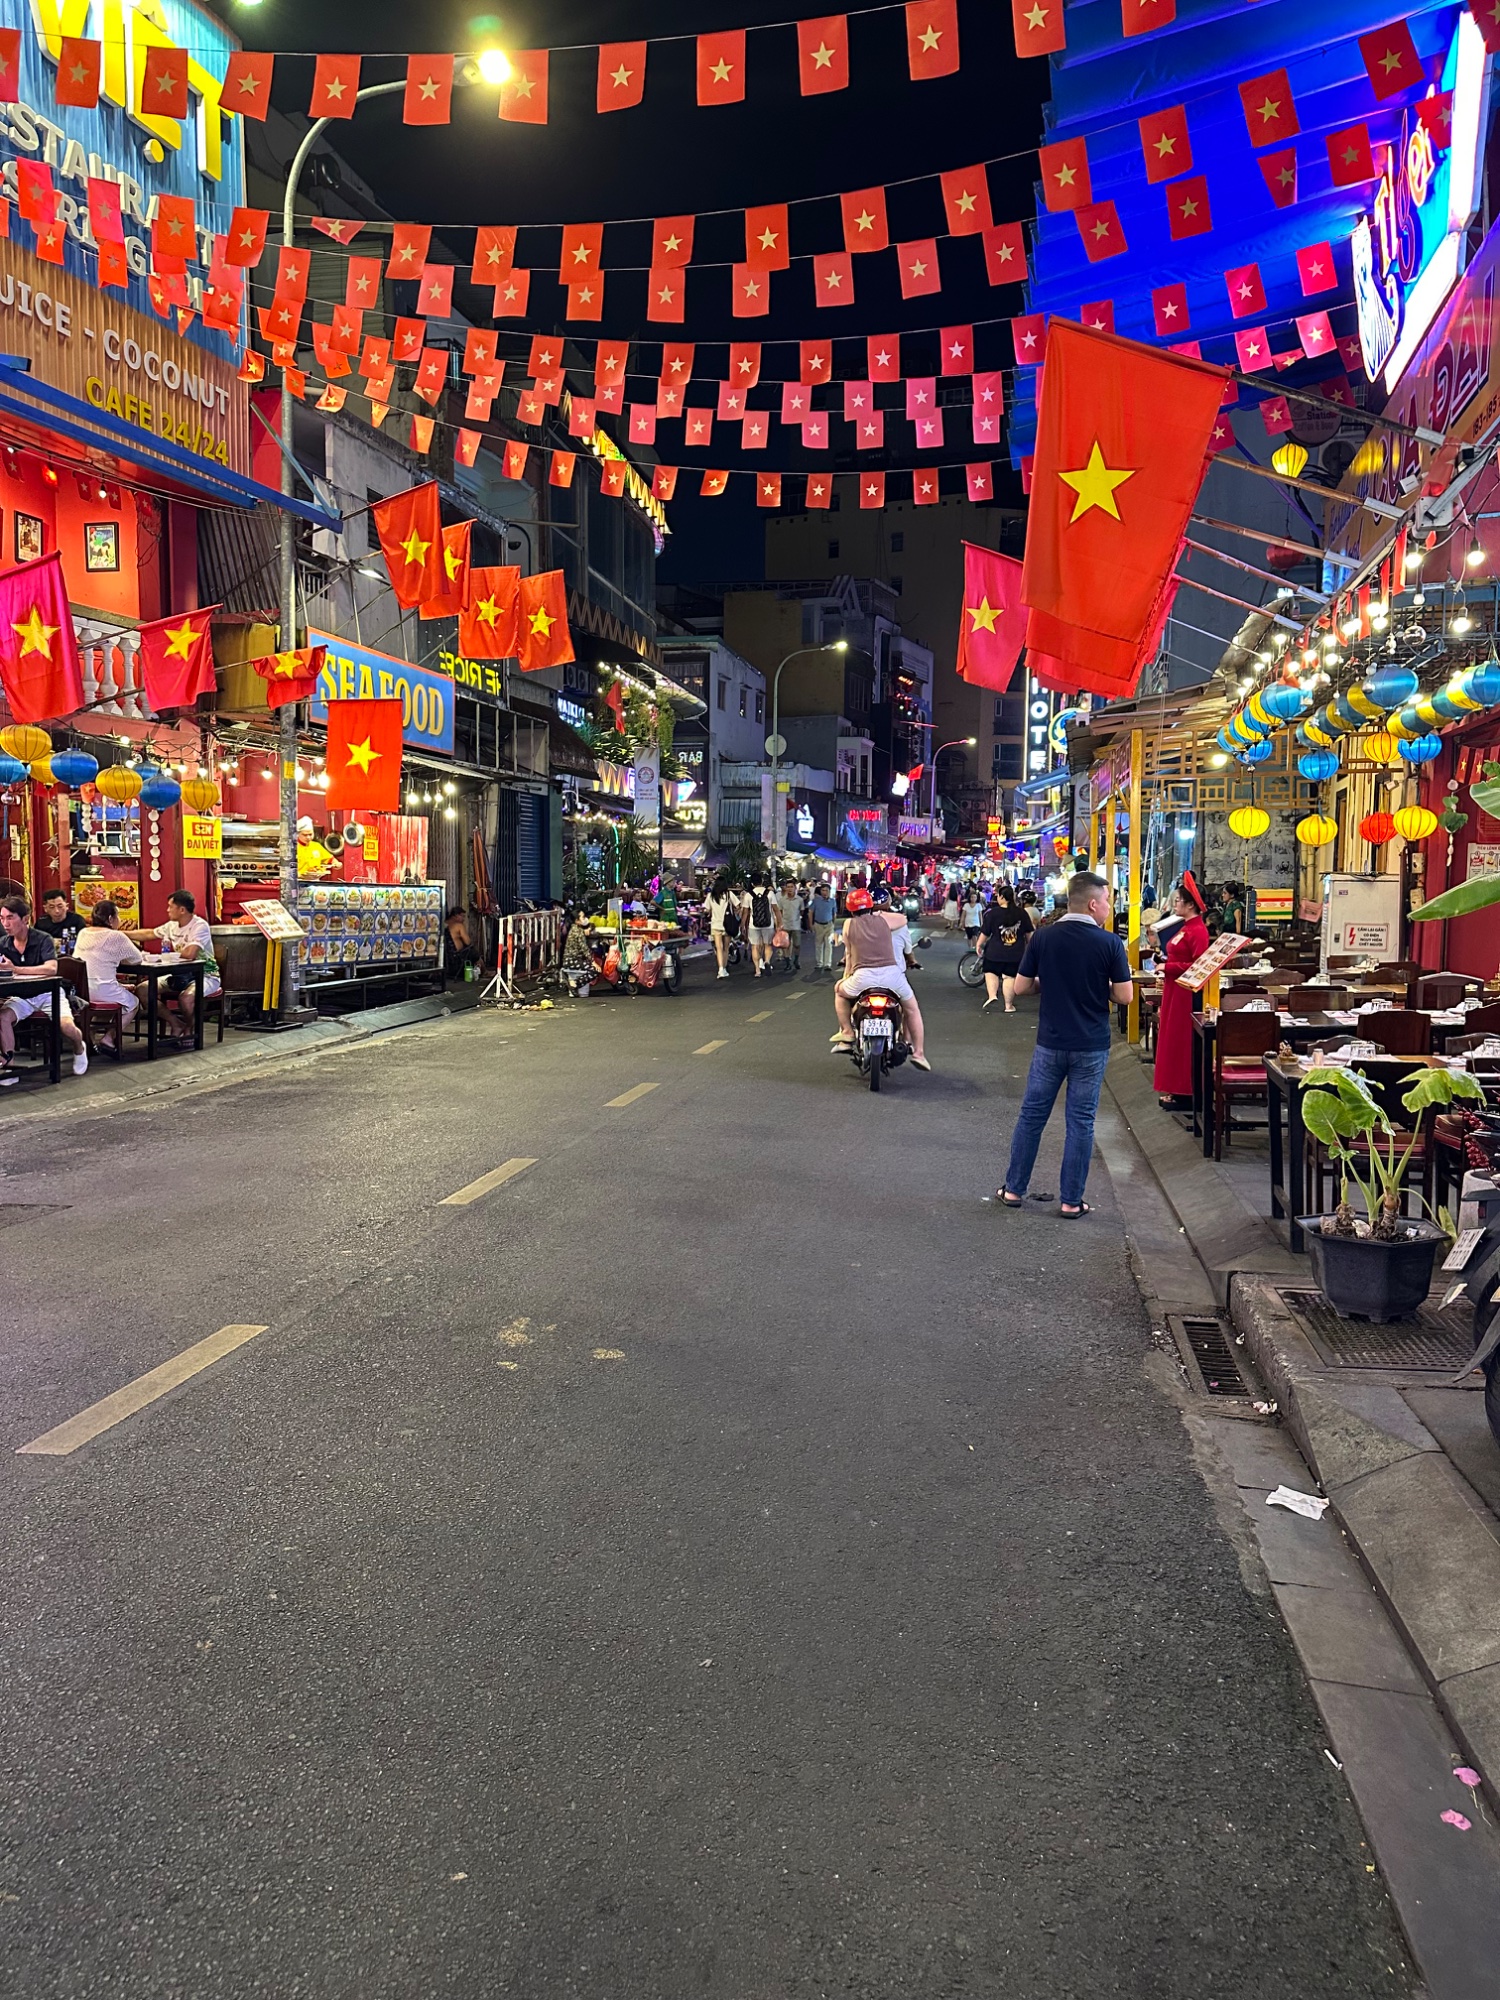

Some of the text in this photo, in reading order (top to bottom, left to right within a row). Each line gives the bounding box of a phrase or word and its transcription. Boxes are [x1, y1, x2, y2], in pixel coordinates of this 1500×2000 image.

[103, 328, 229, 416] COCONUT
[86, 376, 229, 467] CAFE 24/24
[320, 652, 445, 736] SEAFOOD
[194, 823, 213, 835] SEN
